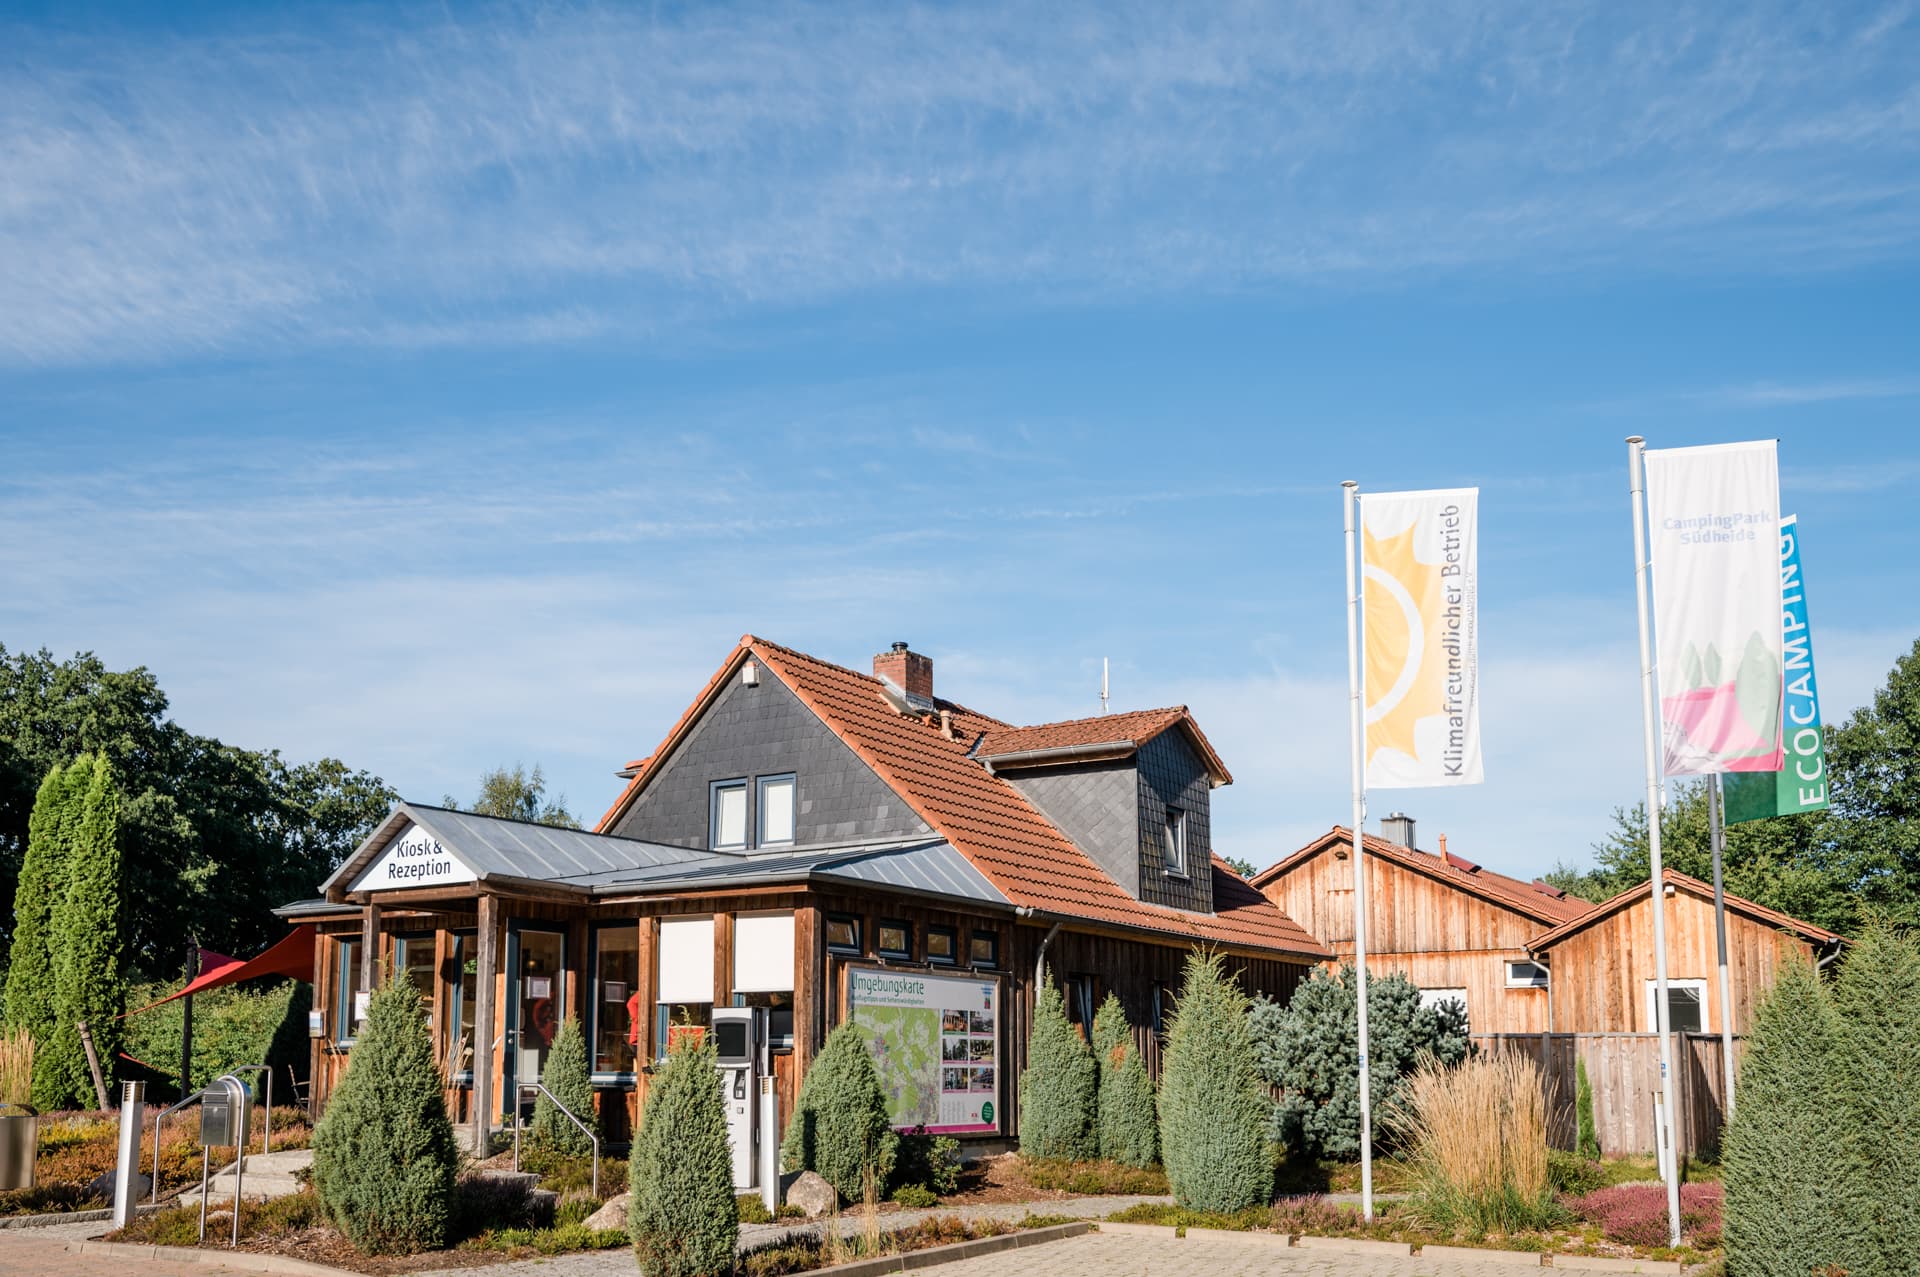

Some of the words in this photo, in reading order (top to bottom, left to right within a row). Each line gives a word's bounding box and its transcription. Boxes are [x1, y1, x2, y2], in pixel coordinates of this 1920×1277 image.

[1663, 510, 1771, 530] CampingPark
[1440, 504, 1461, 577] Betrieb
[1680, 529, 1756, 545] Südheide
[1442, 585, 1463, 776] Klimafreundlicher
[389, 859, 451, 881] Rezeption
[851, 973, 925, 997] Umgebungskarte
